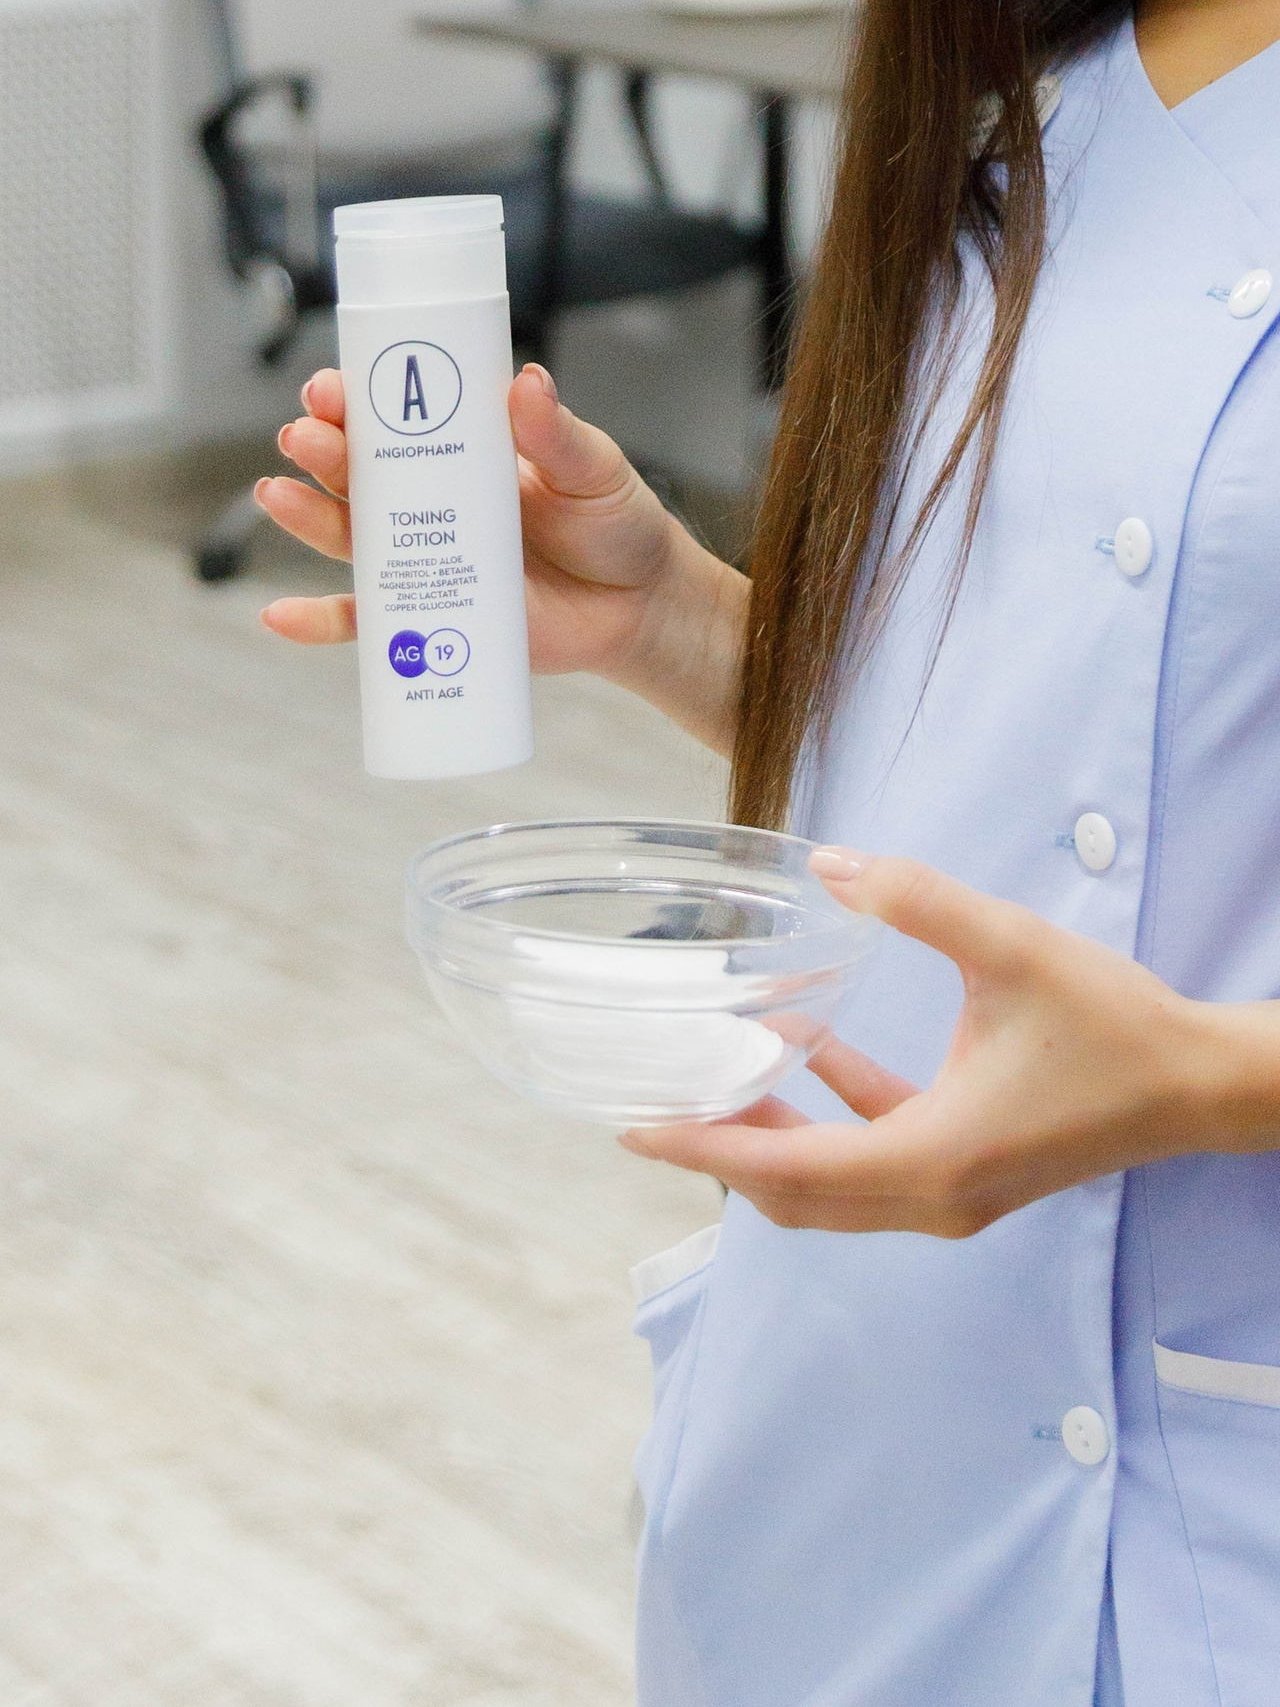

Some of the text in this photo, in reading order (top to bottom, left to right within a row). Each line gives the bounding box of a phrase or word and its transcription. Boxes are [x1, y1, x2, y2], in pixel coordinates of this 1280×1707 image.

[402, 354, 429, 422] A
[374, 441, 465, 459] ANGIOPHARM
[389, 508, 457, 526] TONING
[392, 529, 456, 548] LOTION
[387, 555, 464, 568] FERMENTED ALOE
[380, 565, 475, 579] ERYTHRITOL BETAINE
[379, 576, 479, 590] MAGNESIUM ASPARTATE
[397, 589, 459, 601] ZINC LACTATE
[384, 598, 475, 612] COPPER GLUCONATE
[394, 644, 455, 663] AG 19
[405, 686, 465, 701] ANTI AGE
